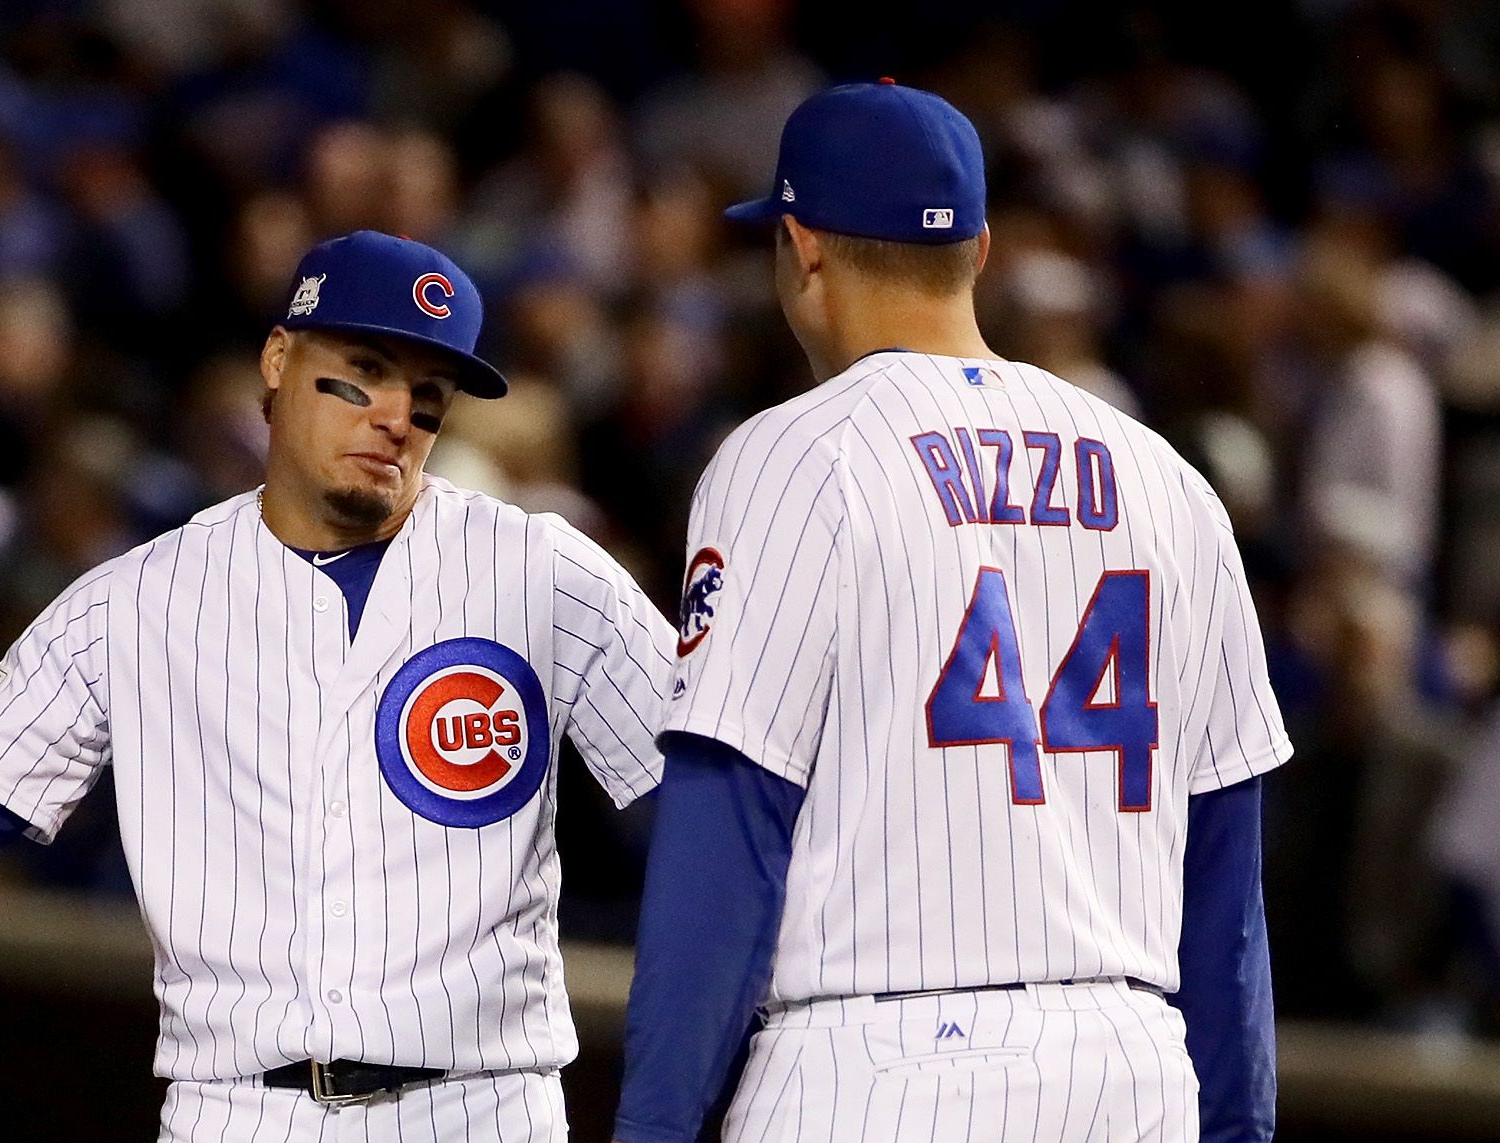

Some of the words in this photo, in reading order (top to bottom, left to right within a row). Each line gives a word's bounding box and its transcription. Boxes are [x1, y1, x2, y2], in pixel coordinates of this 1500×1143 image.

[413, 273, 454, 319] C
[910, 427, 1118, 531] RIZZO
[406, 672, 521, 792] CUBS
[924, 566, 1158, 812] 44
